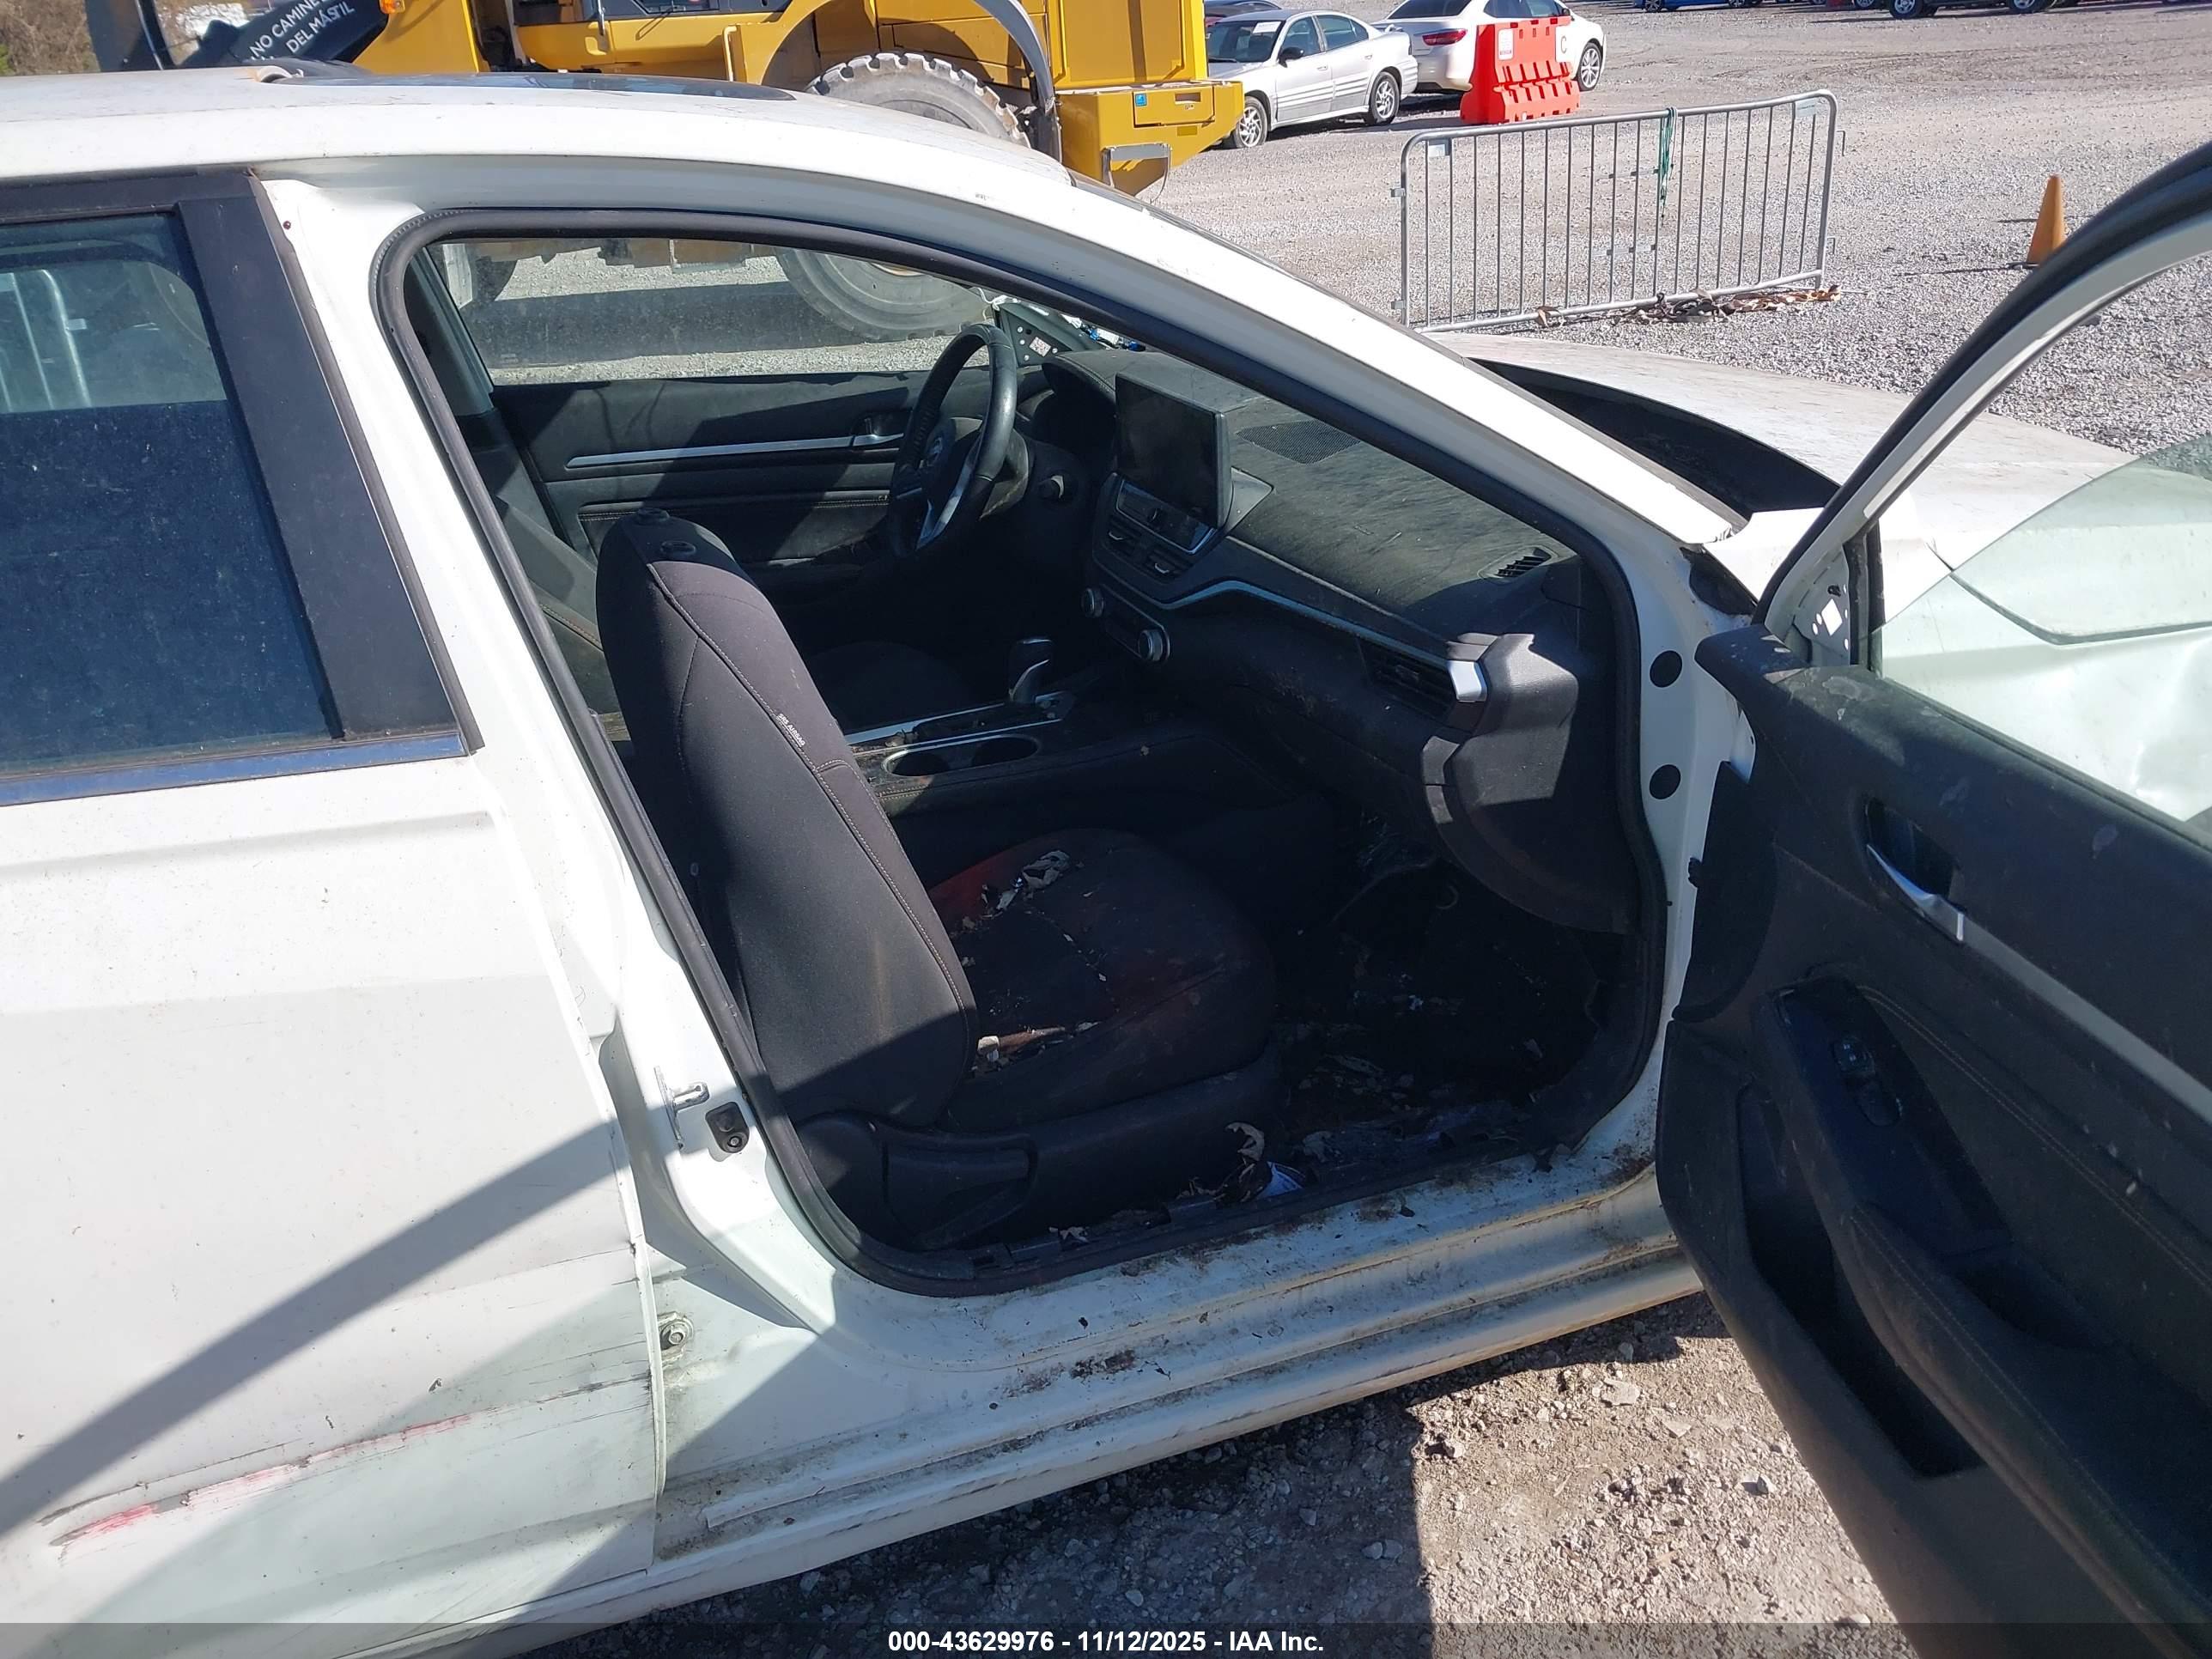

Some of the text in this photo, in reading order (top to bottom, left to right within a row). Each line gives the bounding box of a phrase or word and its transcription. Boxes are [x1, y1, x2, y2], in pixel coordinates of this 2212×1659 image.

[249, 34, 273, 58] NO
[285, 29, 314, 53] DEL
[778, 713, 805, 746] SRS AIRBAG
